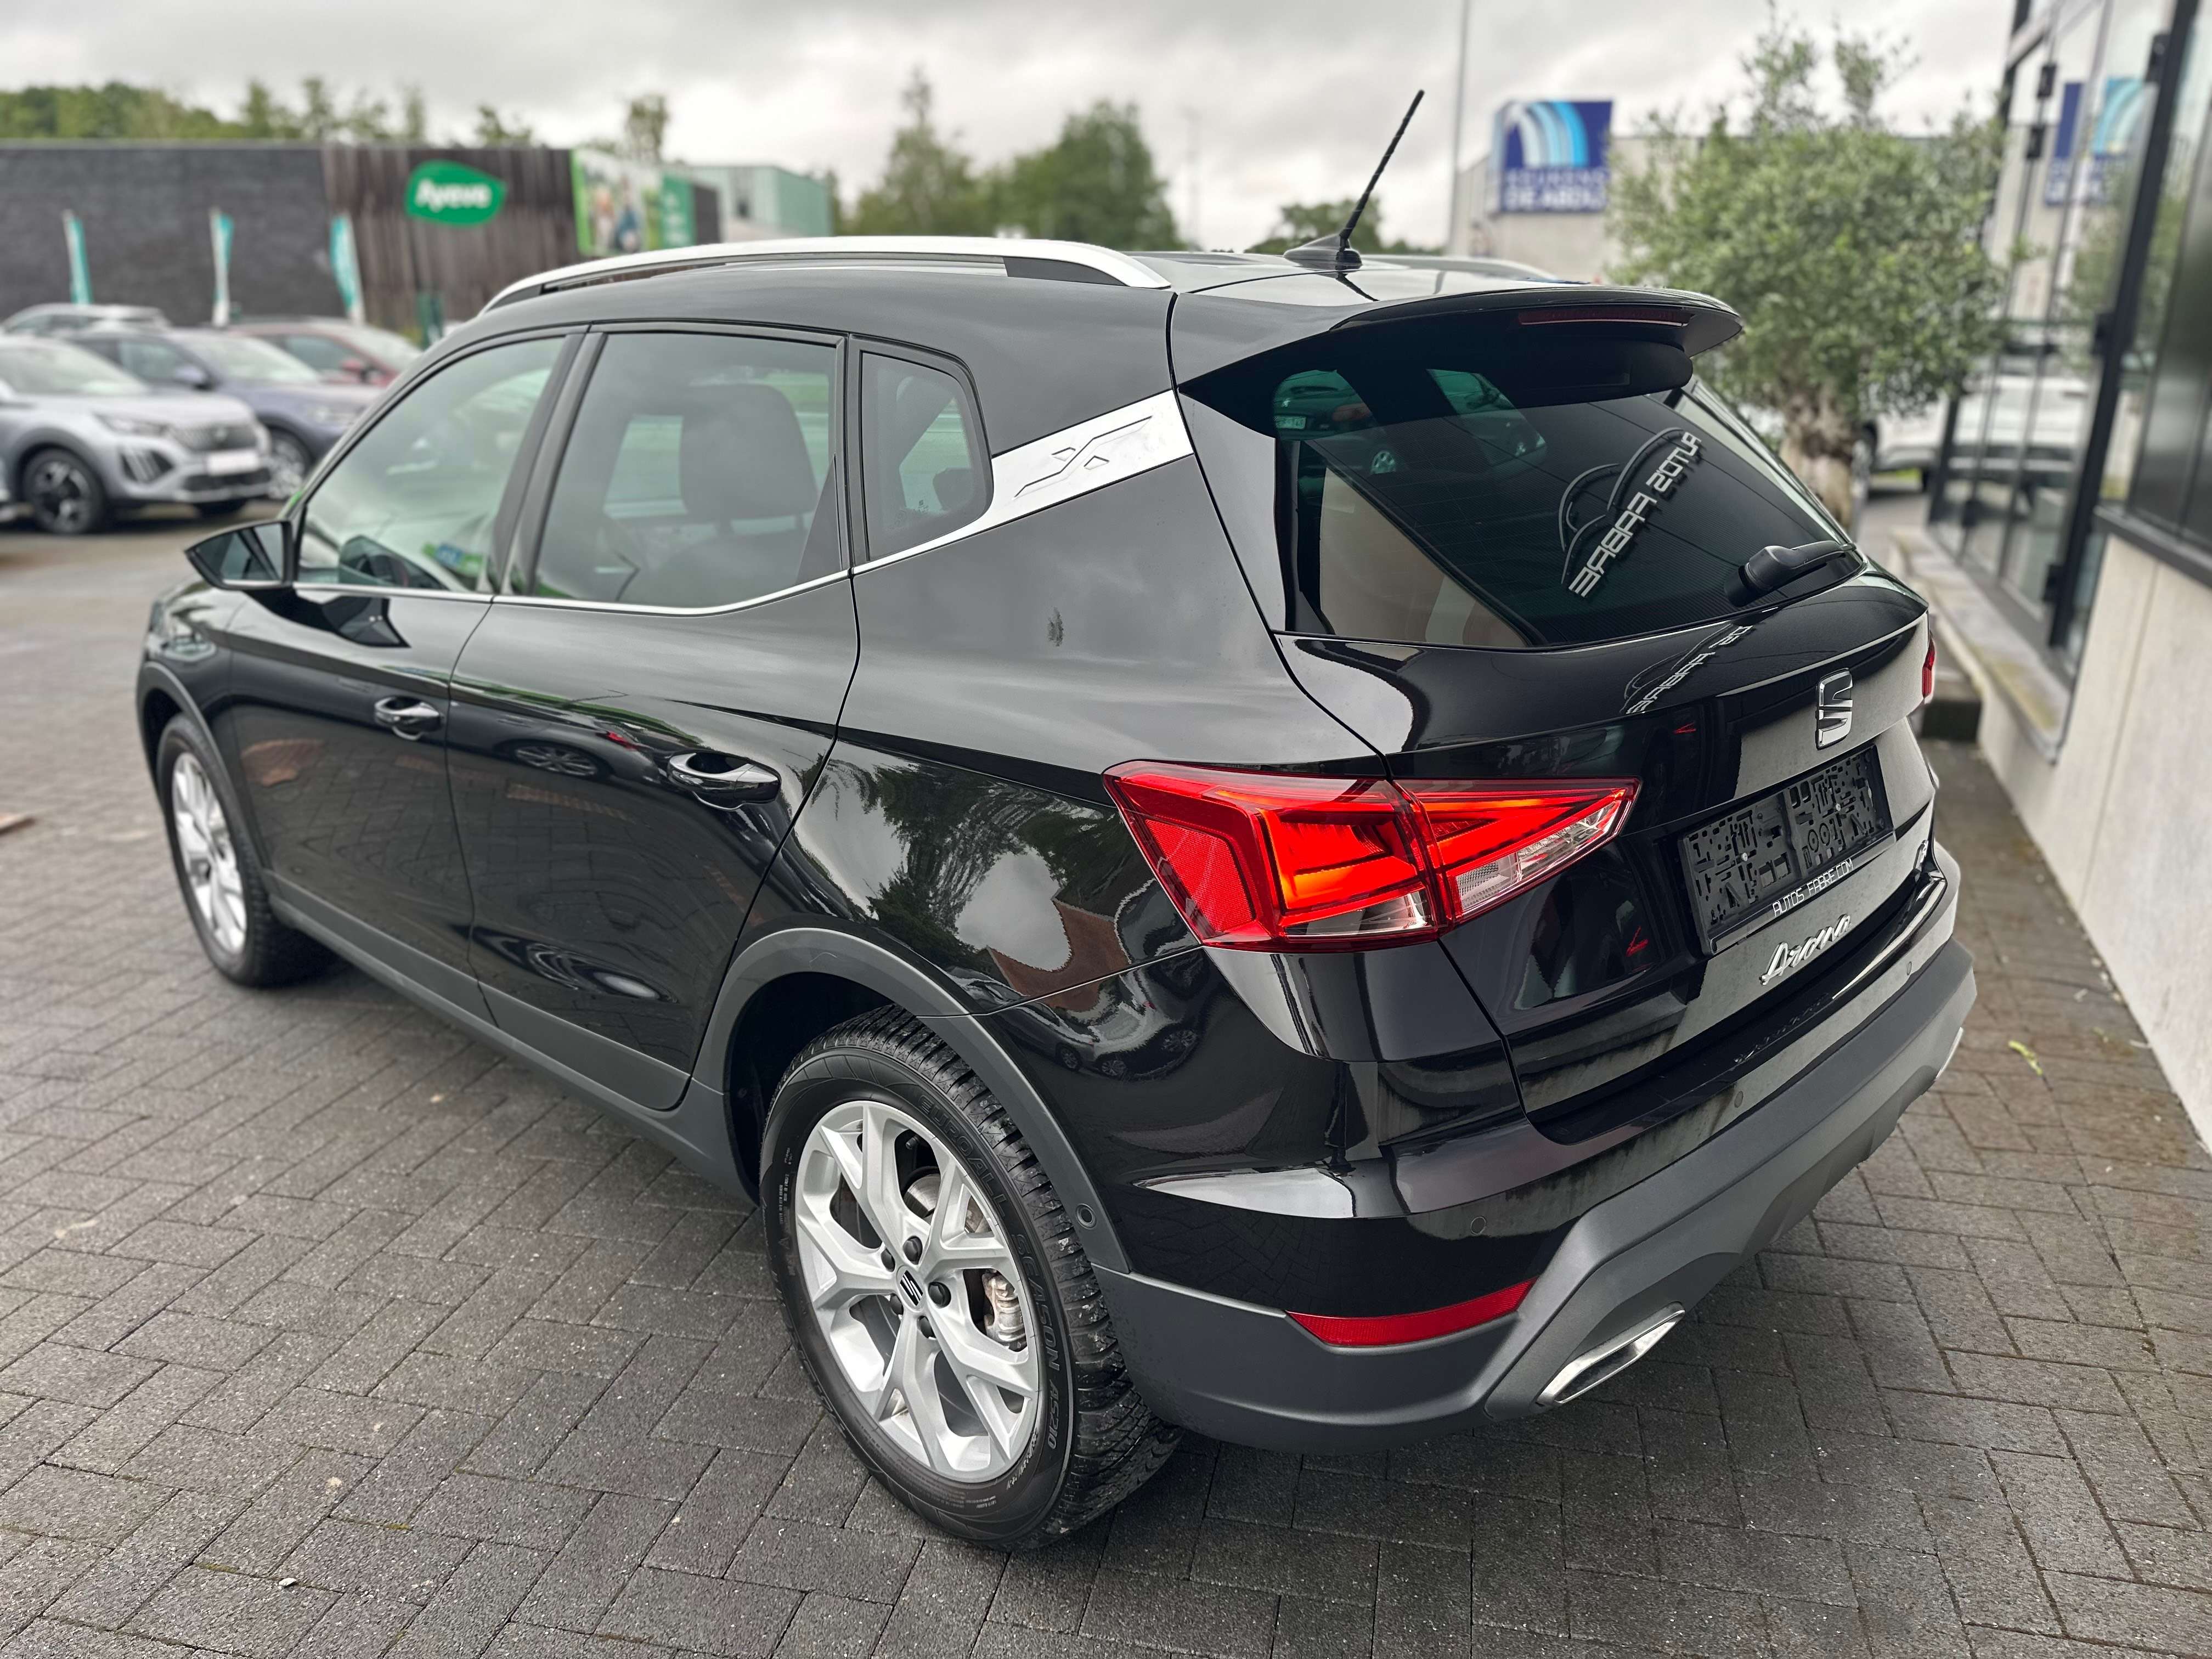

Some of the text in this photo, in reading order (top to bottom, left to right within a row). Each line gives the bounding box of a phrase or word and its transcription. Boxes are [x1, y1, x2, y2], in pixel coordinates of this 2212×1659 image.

[1773, 888, 1804, 917] AUTOS
[1759, 913, 1850, 985] Arona
[1011, 1233, 1060, 1370] SEASON
[1048, 1378, 1059, 1449] AS210
